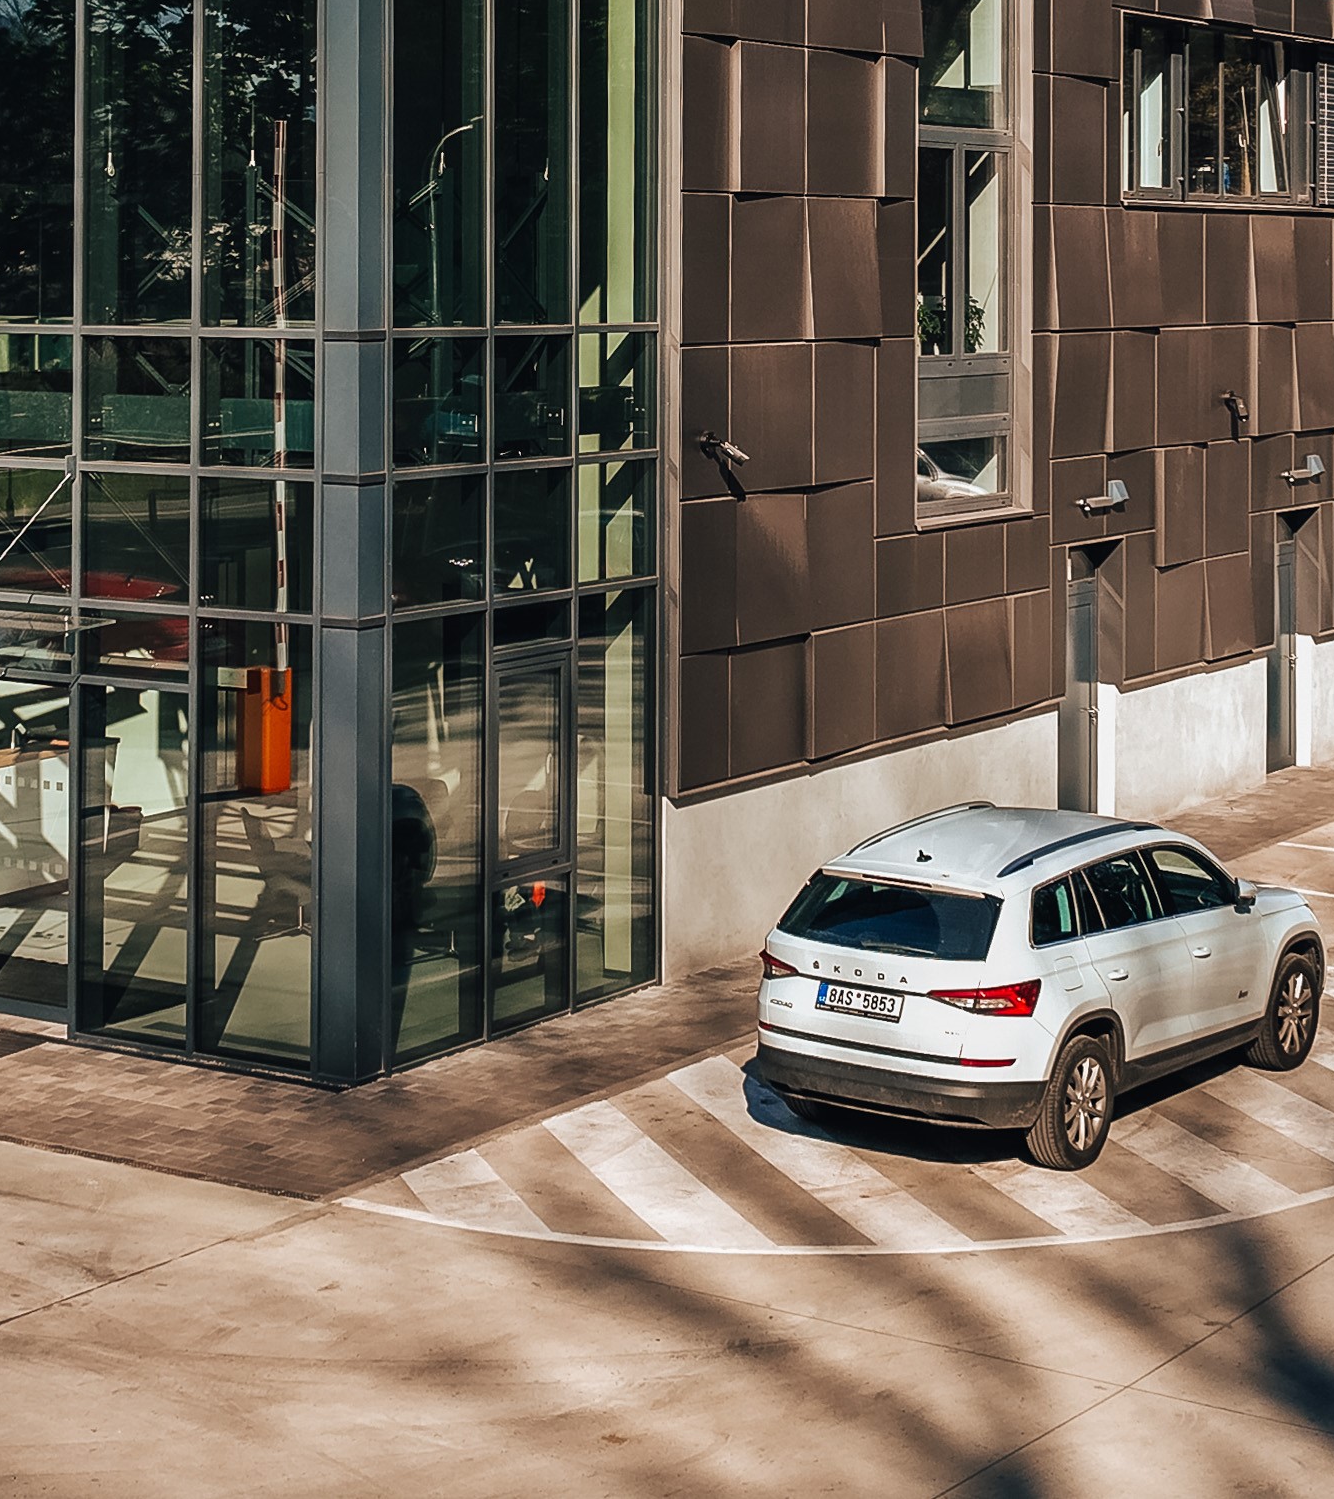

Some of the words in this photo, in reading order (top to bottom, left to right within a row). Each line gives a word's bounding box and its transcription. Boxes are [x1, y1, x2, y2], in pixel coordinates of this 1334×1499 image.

[813, 960, 908, 984] ŠKODA
[829, 988, 854, 1006] 8AS
[862, 993, 896, 1013] 5853
